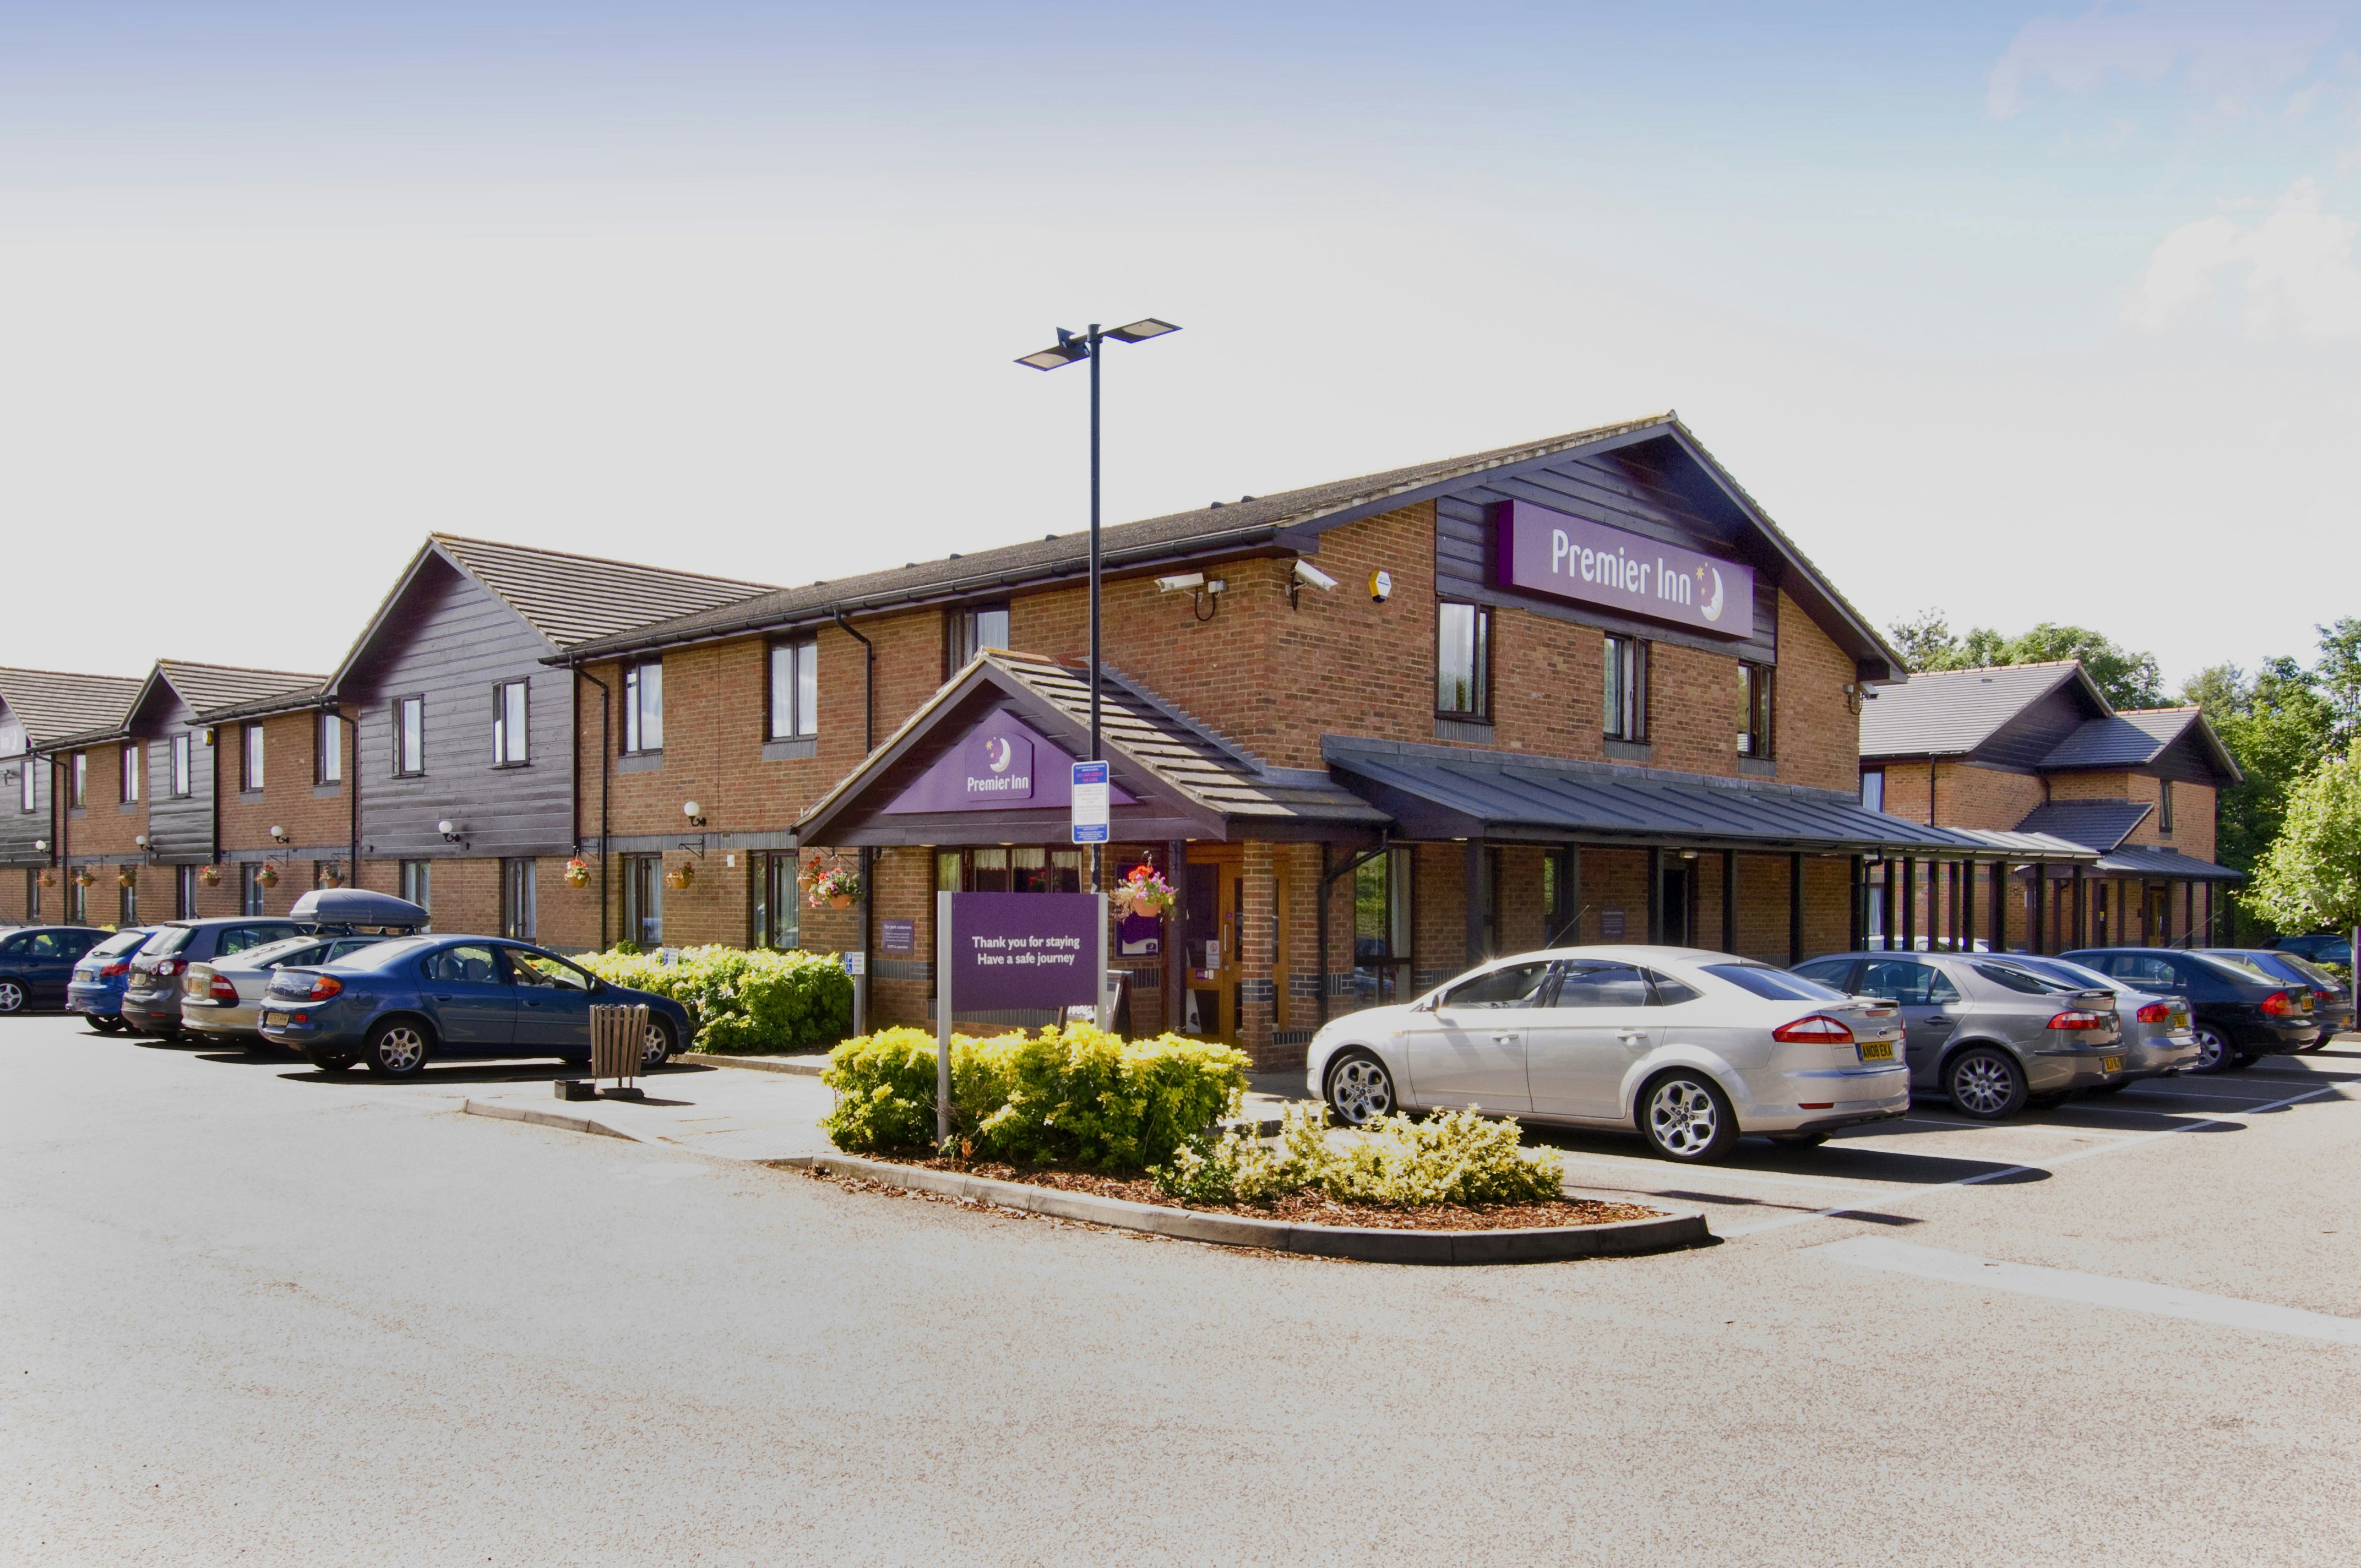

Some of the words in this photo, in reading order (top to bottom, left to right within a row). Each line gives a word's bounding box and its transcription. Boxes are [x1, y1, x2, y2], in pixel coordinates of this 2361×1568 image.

[1552, 529, 1650, 595] Premier
[1657, 557, 1691, 605] Inn
[967, 775, 1010, 792] Premier
[1011, 774, 1029, 790] Inn
[972, 936, 1006, 948] Thank
[1008, 938, 1026, 950] you
[1029, 935, 1044, 947] for
[1046, 935, 1080, 950] staying
[977, 953, 1004, 965] Have
[1007, 955, 1013, 964] a
[1015, 952, 1035, 963] safe
[1037, 952, 1075, 966] journey
[1862, 1044, 1880, 1058] AN08
[1880, 1043, 1892, 1057] EKA
